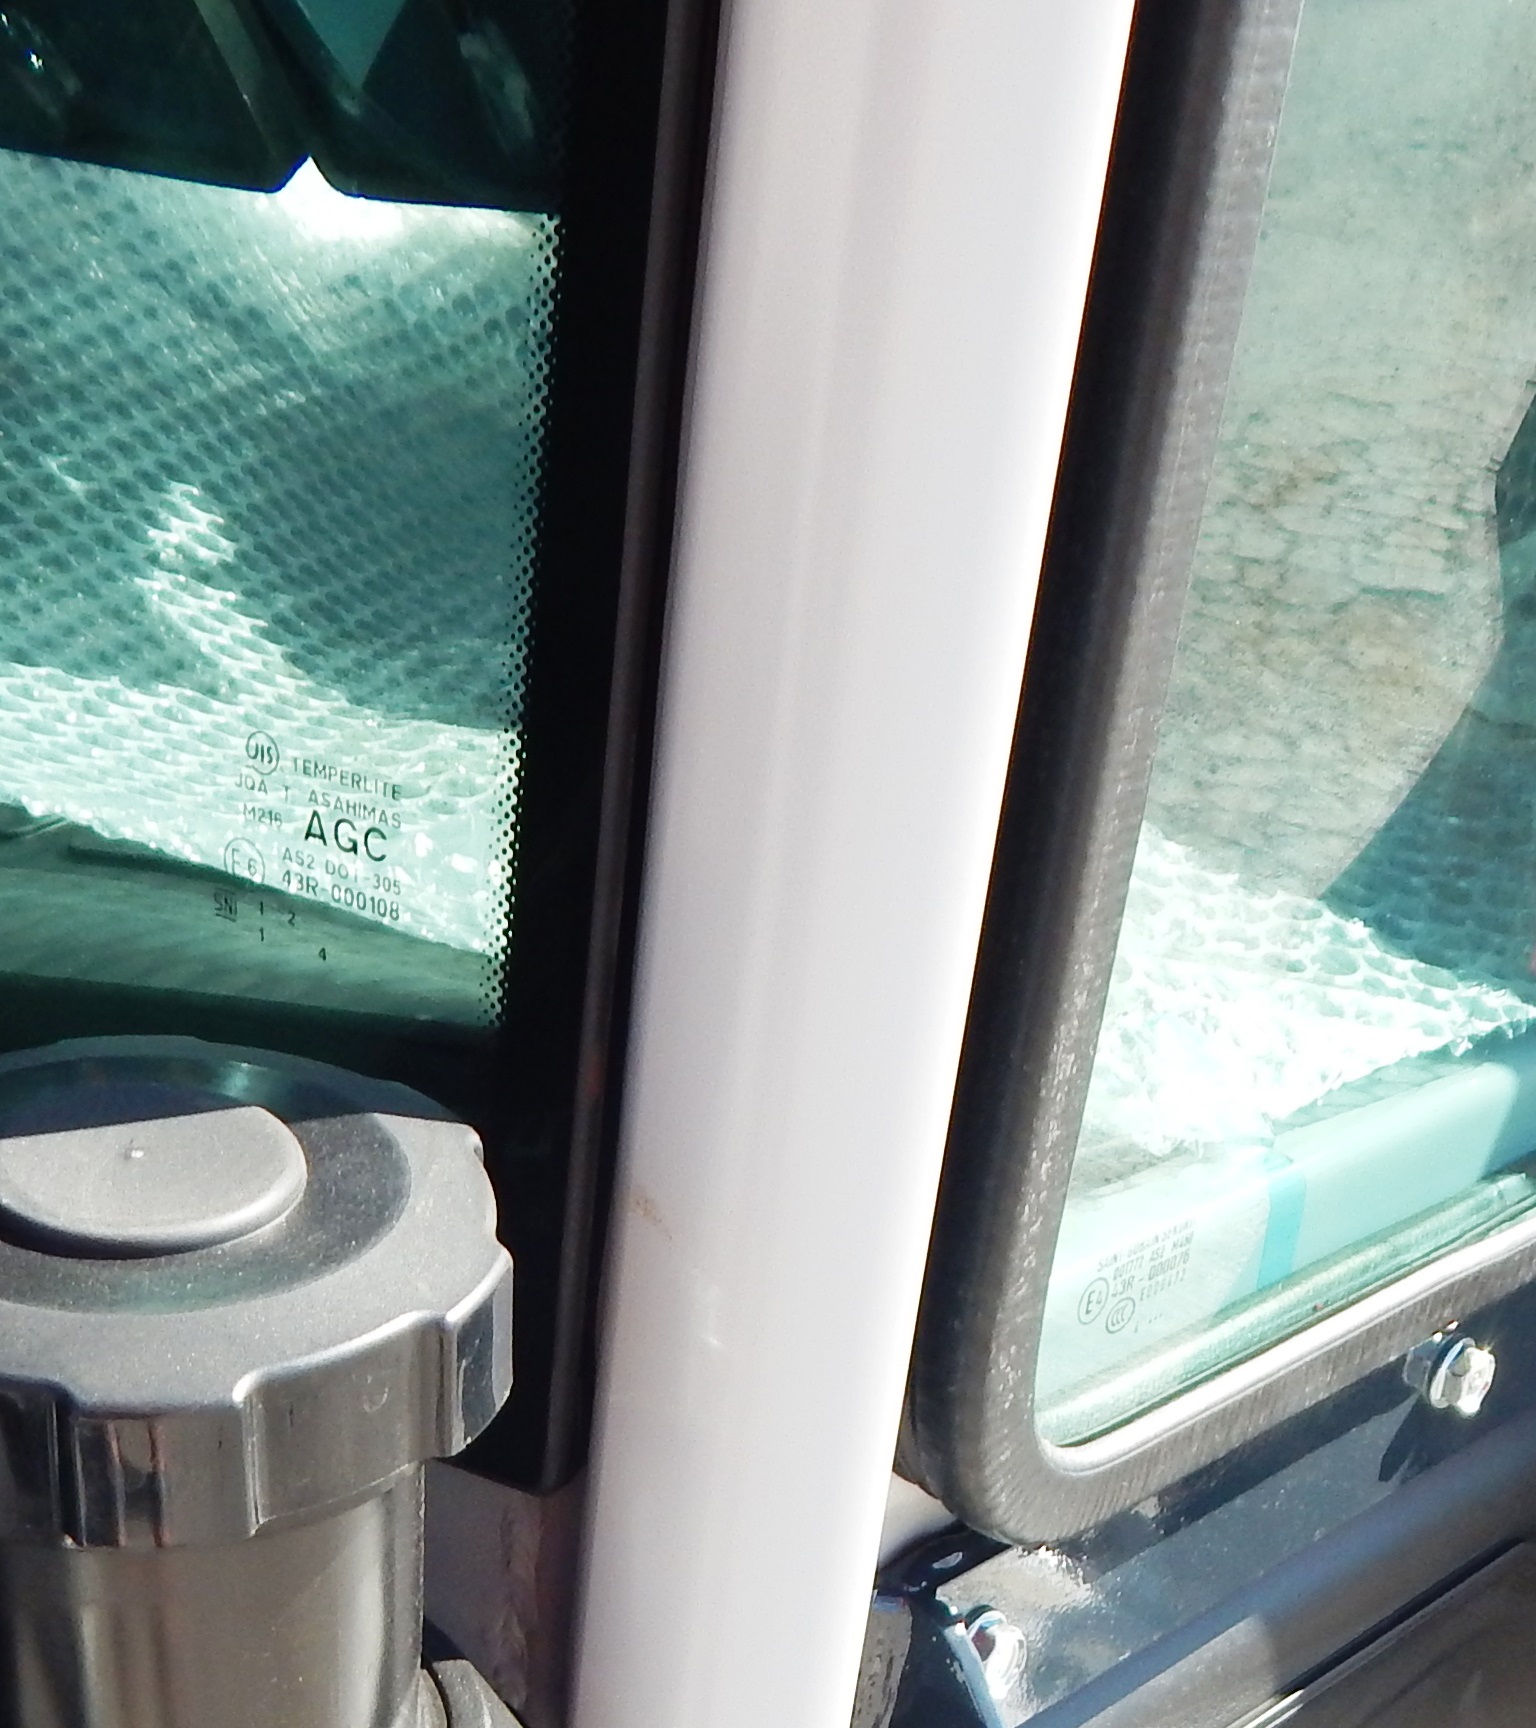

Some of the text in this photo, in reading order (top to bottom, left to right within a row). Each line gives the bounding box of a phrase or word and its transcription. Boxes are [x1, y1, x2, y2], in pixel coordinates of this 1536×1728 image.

[292, 756, 403, 801] TEMPERLITE
[307, 789, 402, 829] ASAHIMAS
[303, 809, 388, 862] AGC
[282, 847, 316, 871] AS2
